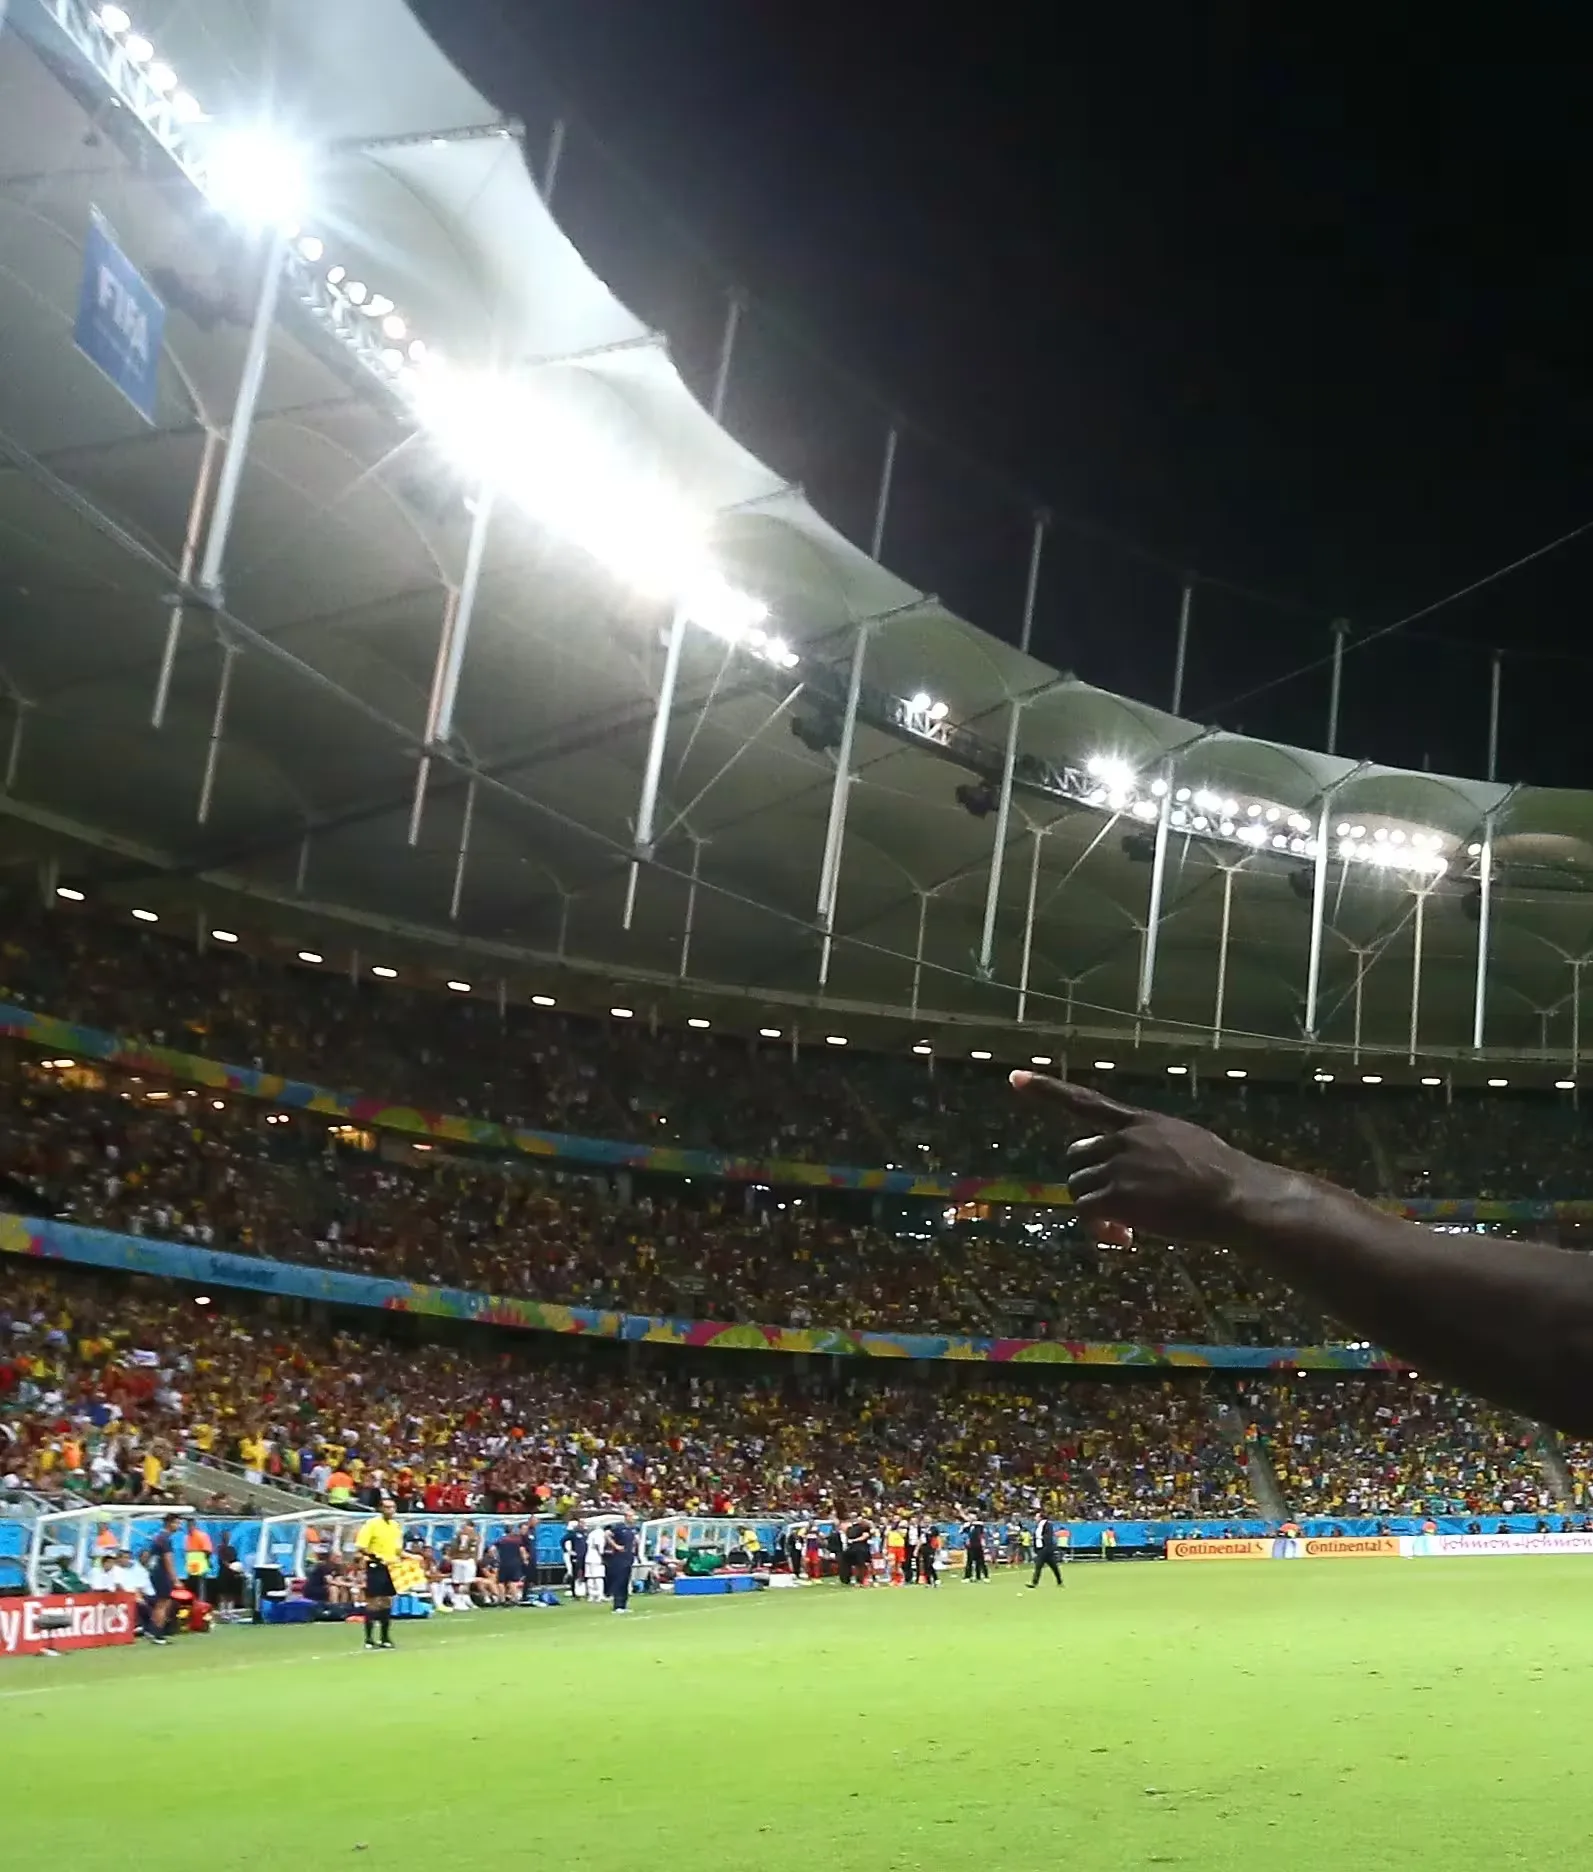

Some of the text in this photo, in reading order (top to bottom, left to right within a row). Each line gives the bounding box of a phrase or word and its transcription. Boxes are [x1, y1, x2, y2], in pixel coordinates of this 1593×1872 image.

[97, 265, 149, 363] FIFA
[1174, 1542, 1251, 1557] Continental
[1306, 1540, 1382, 1554] Continental
